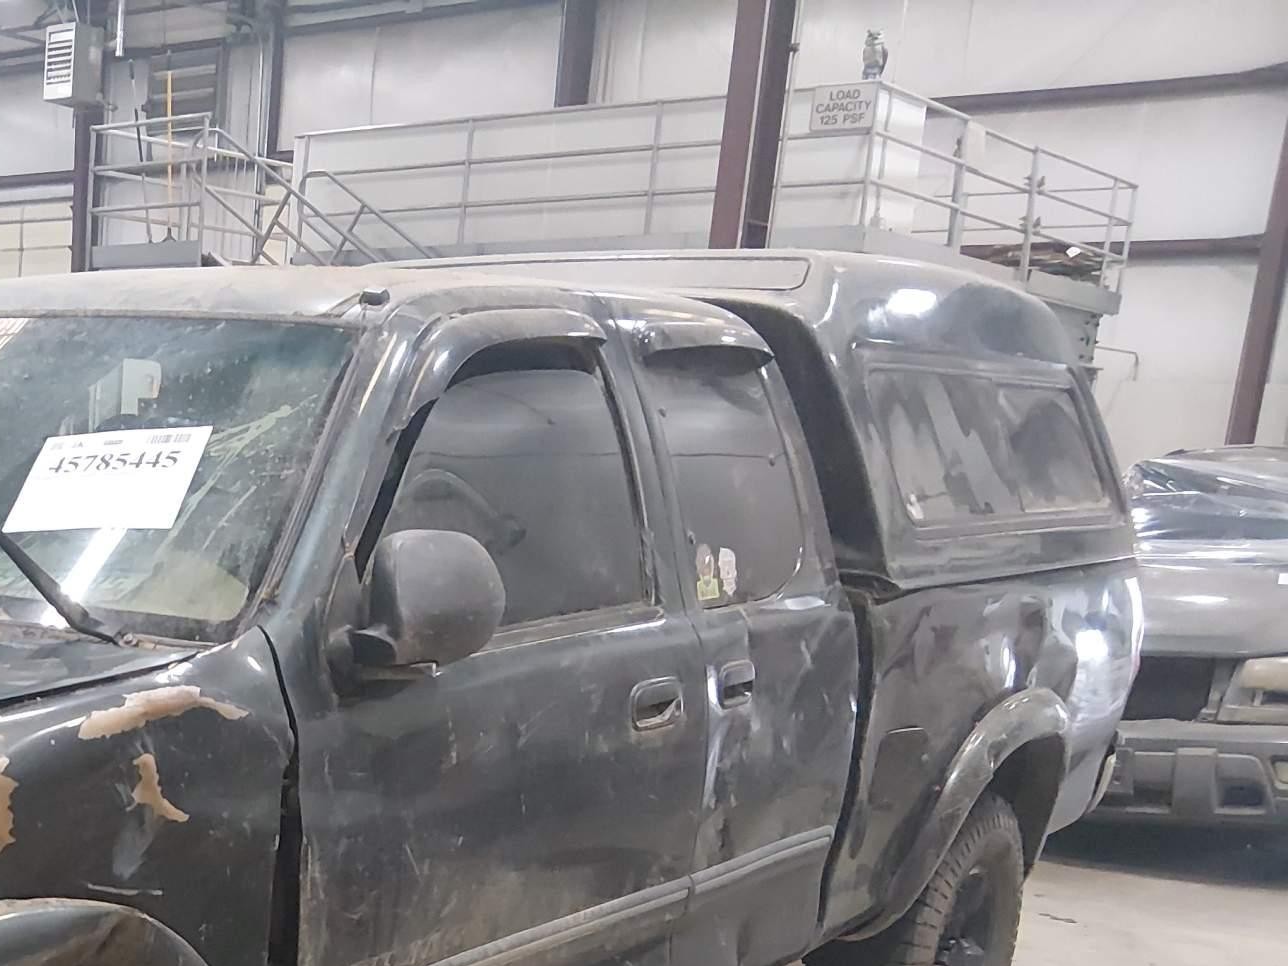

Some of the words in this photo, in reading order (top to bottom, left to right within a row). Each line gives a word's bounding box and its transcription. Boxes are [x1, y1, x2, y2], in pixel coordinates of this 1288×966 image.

[829, 89, 861, 102] LOAD
[815, 100, 872, 114] CAPACITY
[819, 114, 838, 126] 125
[842, 112, 865, 124] PSF
[48, 450, 182, 474] 45785445
